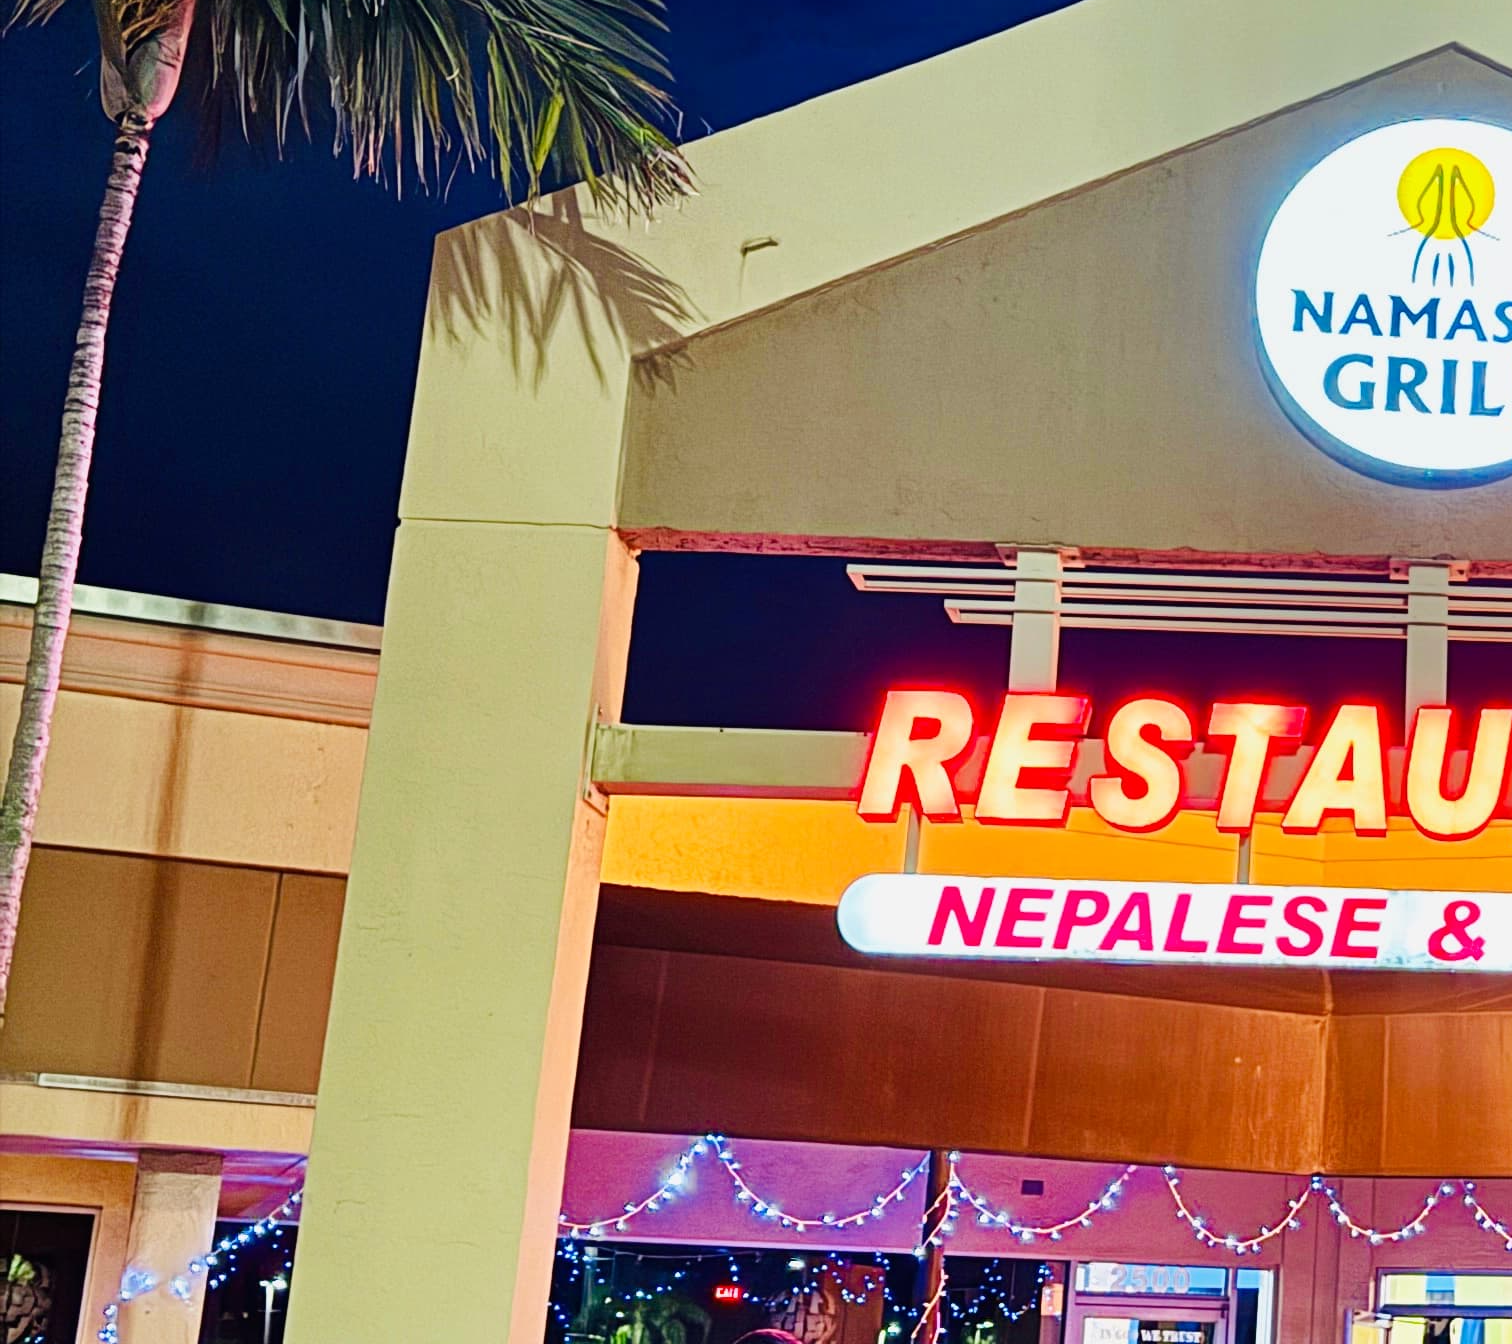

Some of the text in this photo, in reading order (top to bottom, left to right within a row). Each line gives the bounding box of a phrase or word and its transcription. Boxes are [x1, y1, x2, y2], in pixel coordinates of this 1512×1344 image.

[928, 885, 1388, 960] NEPALESE
[1427, 900, 1486, 963] &
[1110, 1266, 1191, 1294] 2500
